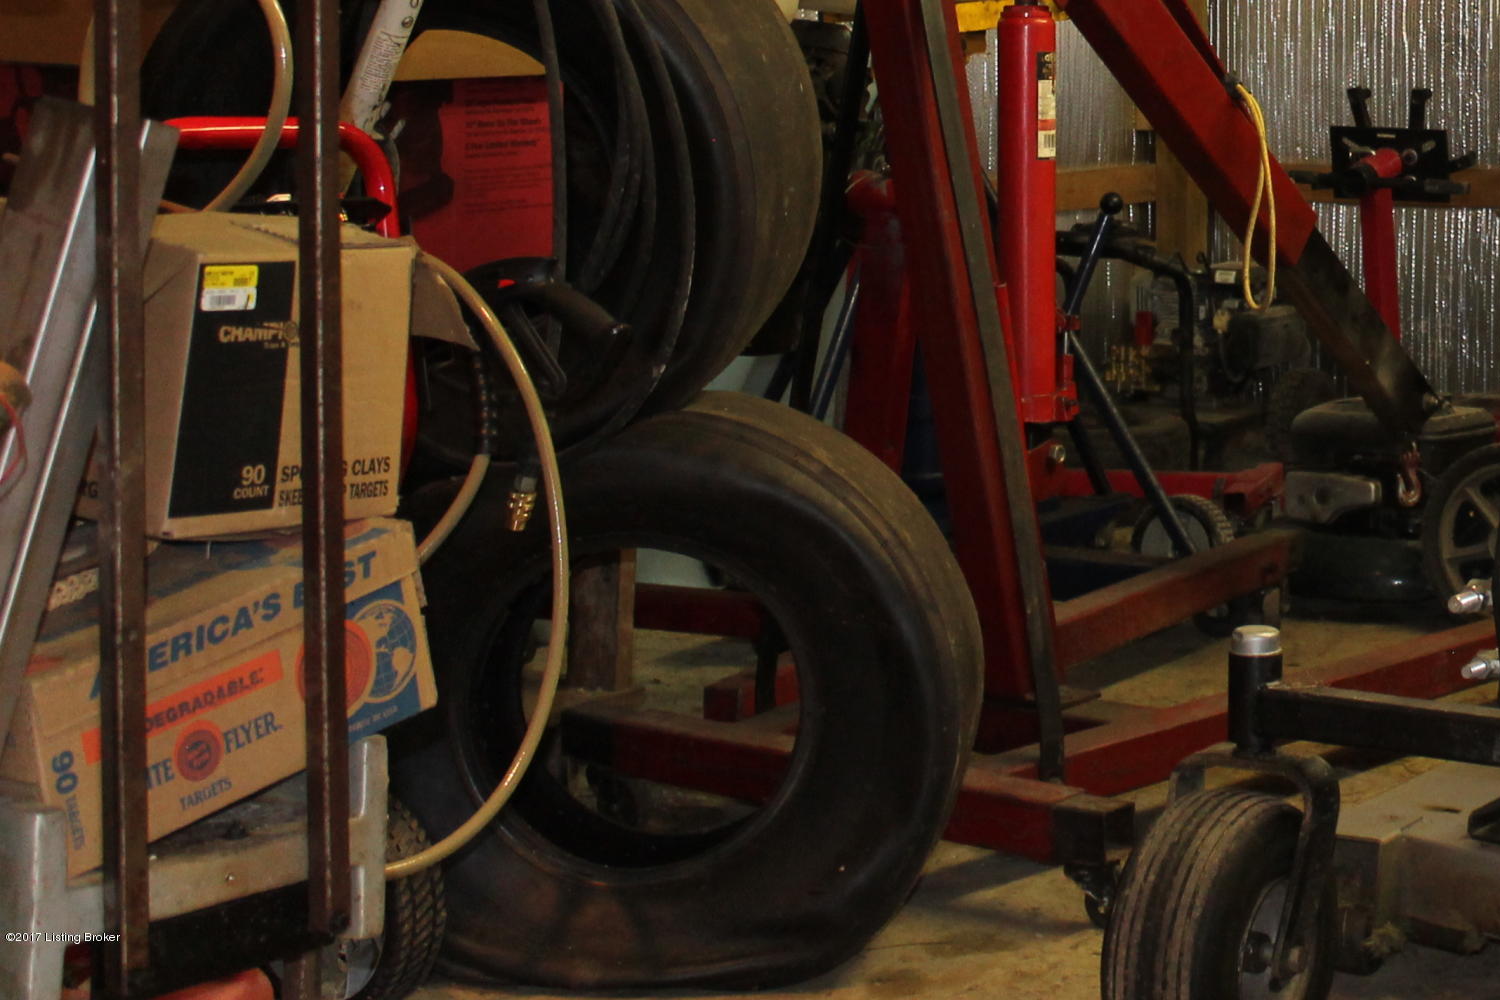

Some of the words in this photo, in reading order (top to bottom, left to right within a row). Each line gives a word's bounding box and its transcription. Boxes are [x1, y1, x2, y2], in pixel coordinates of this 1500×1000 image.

[240, 464, 266, 486] 90
[351, 456, 391, 476] CLAYS
[232, 485, 270, 500] COUNT
[350, 480, 389, 500] TARGETS
[52, 750, 79, 795] 90
[180, 776, 232, 812] TARGETS
